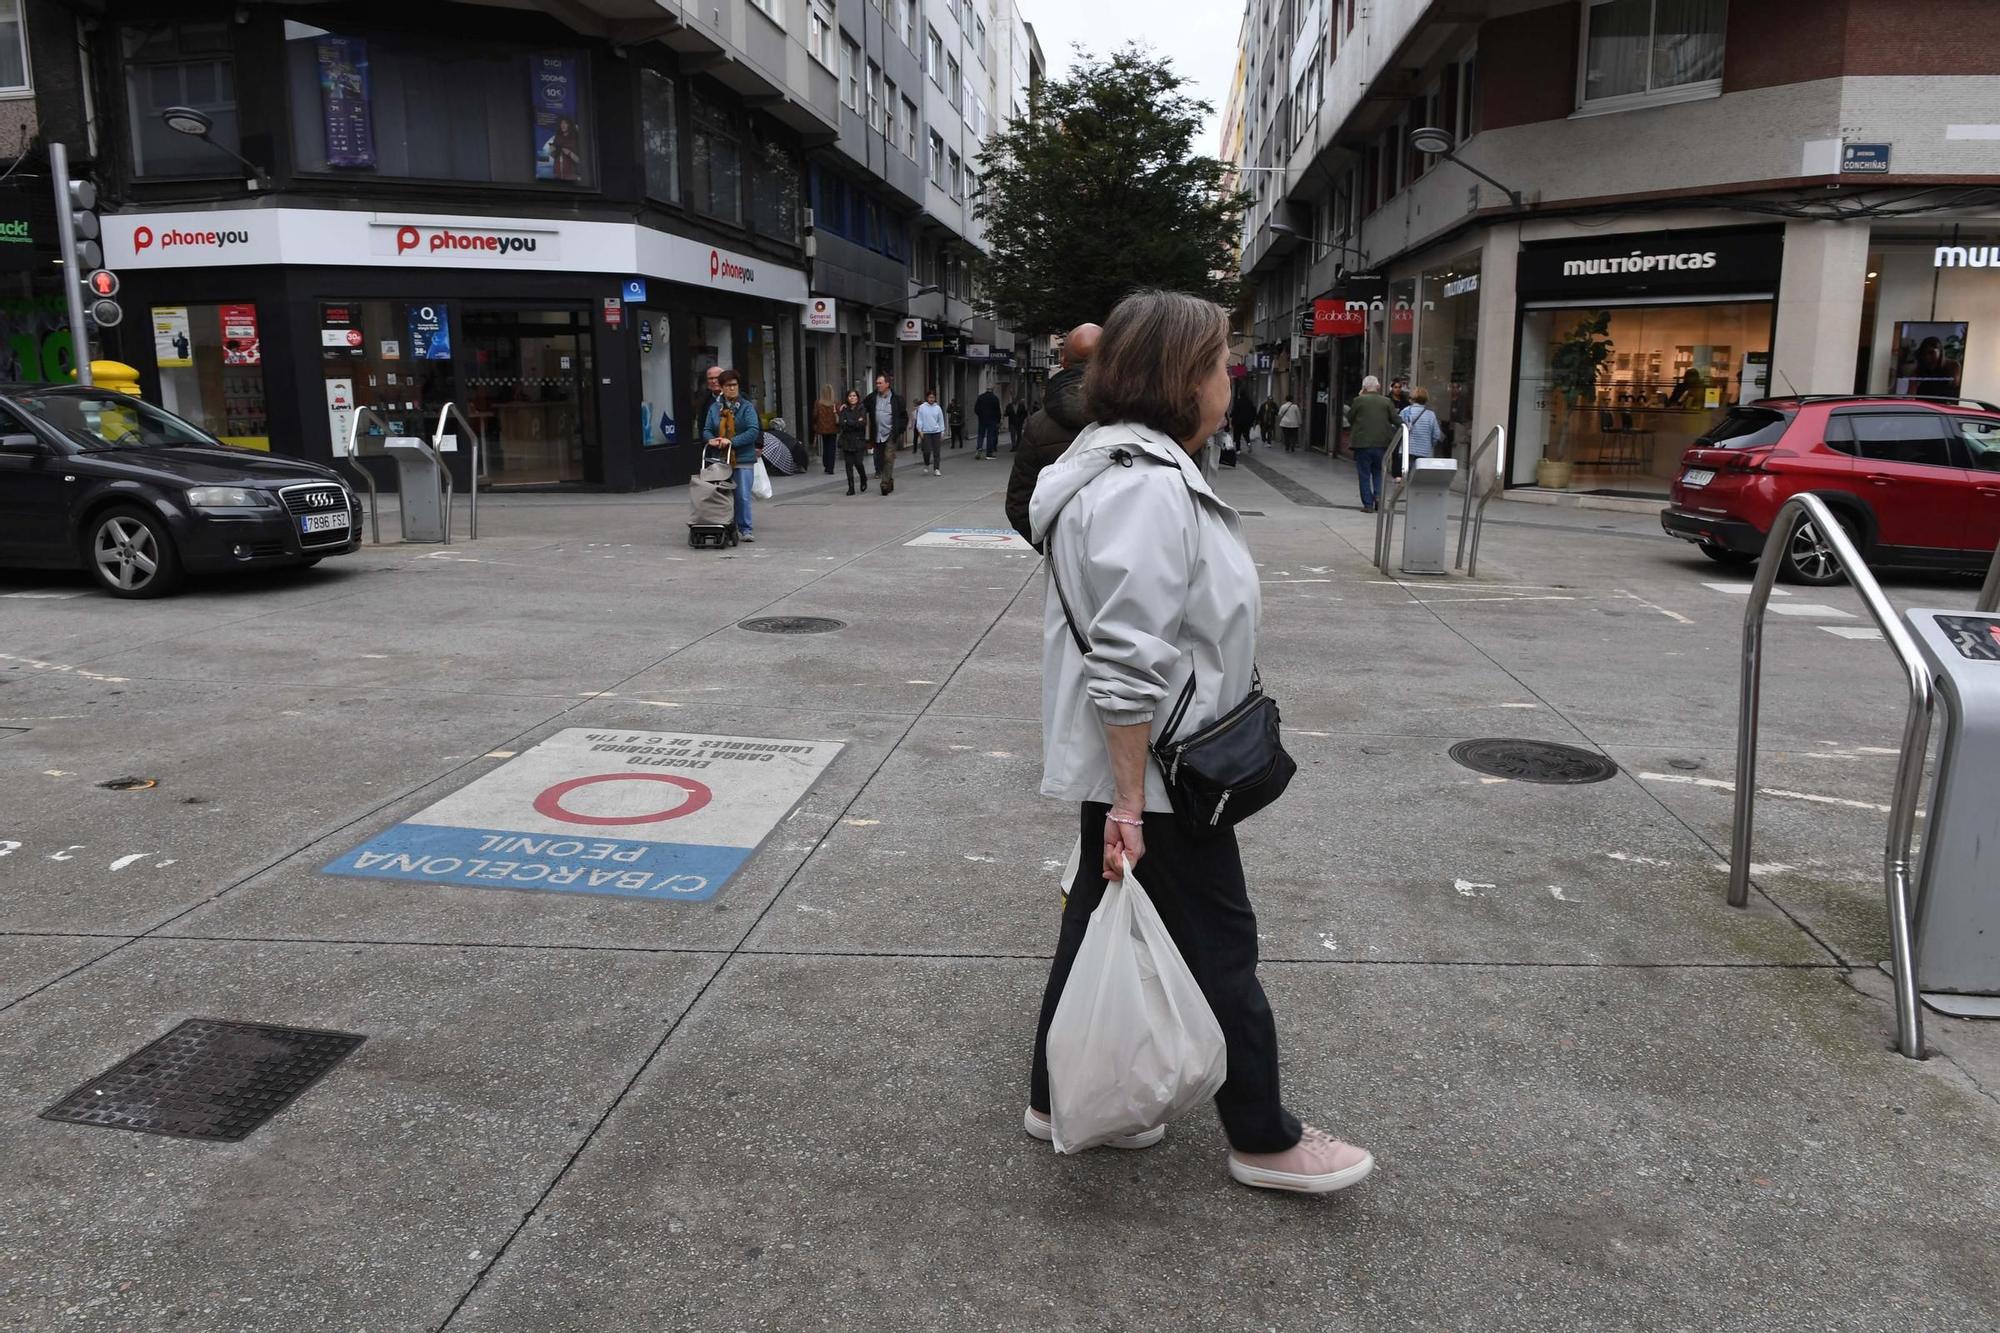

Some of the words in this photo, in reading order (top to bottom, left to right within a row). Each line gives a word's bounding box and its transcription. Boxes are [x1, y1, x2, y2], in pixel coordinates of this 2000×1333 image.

[1844, 160, 1887, 170] CONCHIÑAS
[161, 229, 249, 250] phoneyou
[430, 229, 537, 254] phoneyou
[721, 257, 754, 285] phoneyou
[420, 306, 438, 323] O2
[308, 516, 330, 531] 7896
[332, 513, 347, 528] FSZ
[624, 735, 640, 744] A
[667, 738, 694, 747] DE
[591, 743, 692, 756] DESCARGA
[700, 740, 815, 754] LABORABLES
[627, 756, 711, 769] EXCEPTO
[710, 749, 775, 762] CARGA
[477, 834, 649, 862] PEONIL
